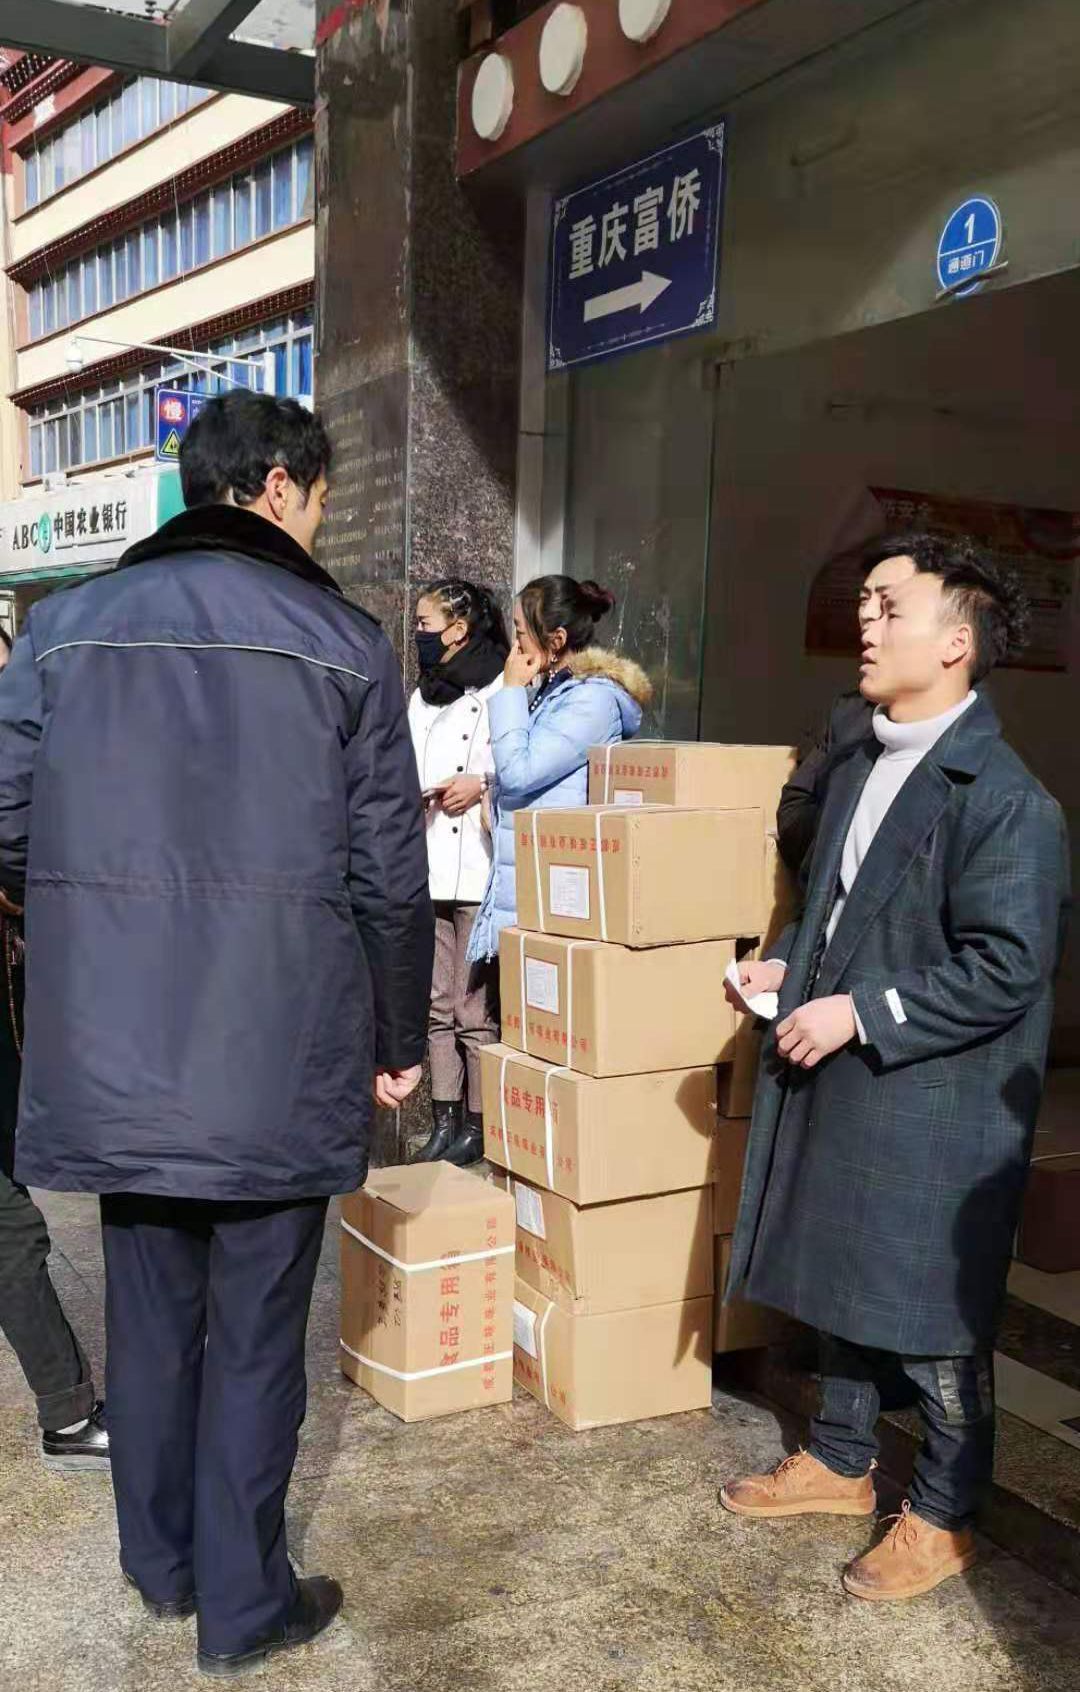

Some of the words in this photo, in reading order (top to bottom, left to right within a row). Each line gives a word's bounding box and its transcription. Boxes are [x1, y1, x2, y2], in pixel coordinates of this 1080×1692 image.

[569, 168, 702, 280] 重庆富侨
[964, 213, 976, 244] 1
[12, 522, 39, 551] ABC
[53, 501, 127, 540] 中国农业银行
